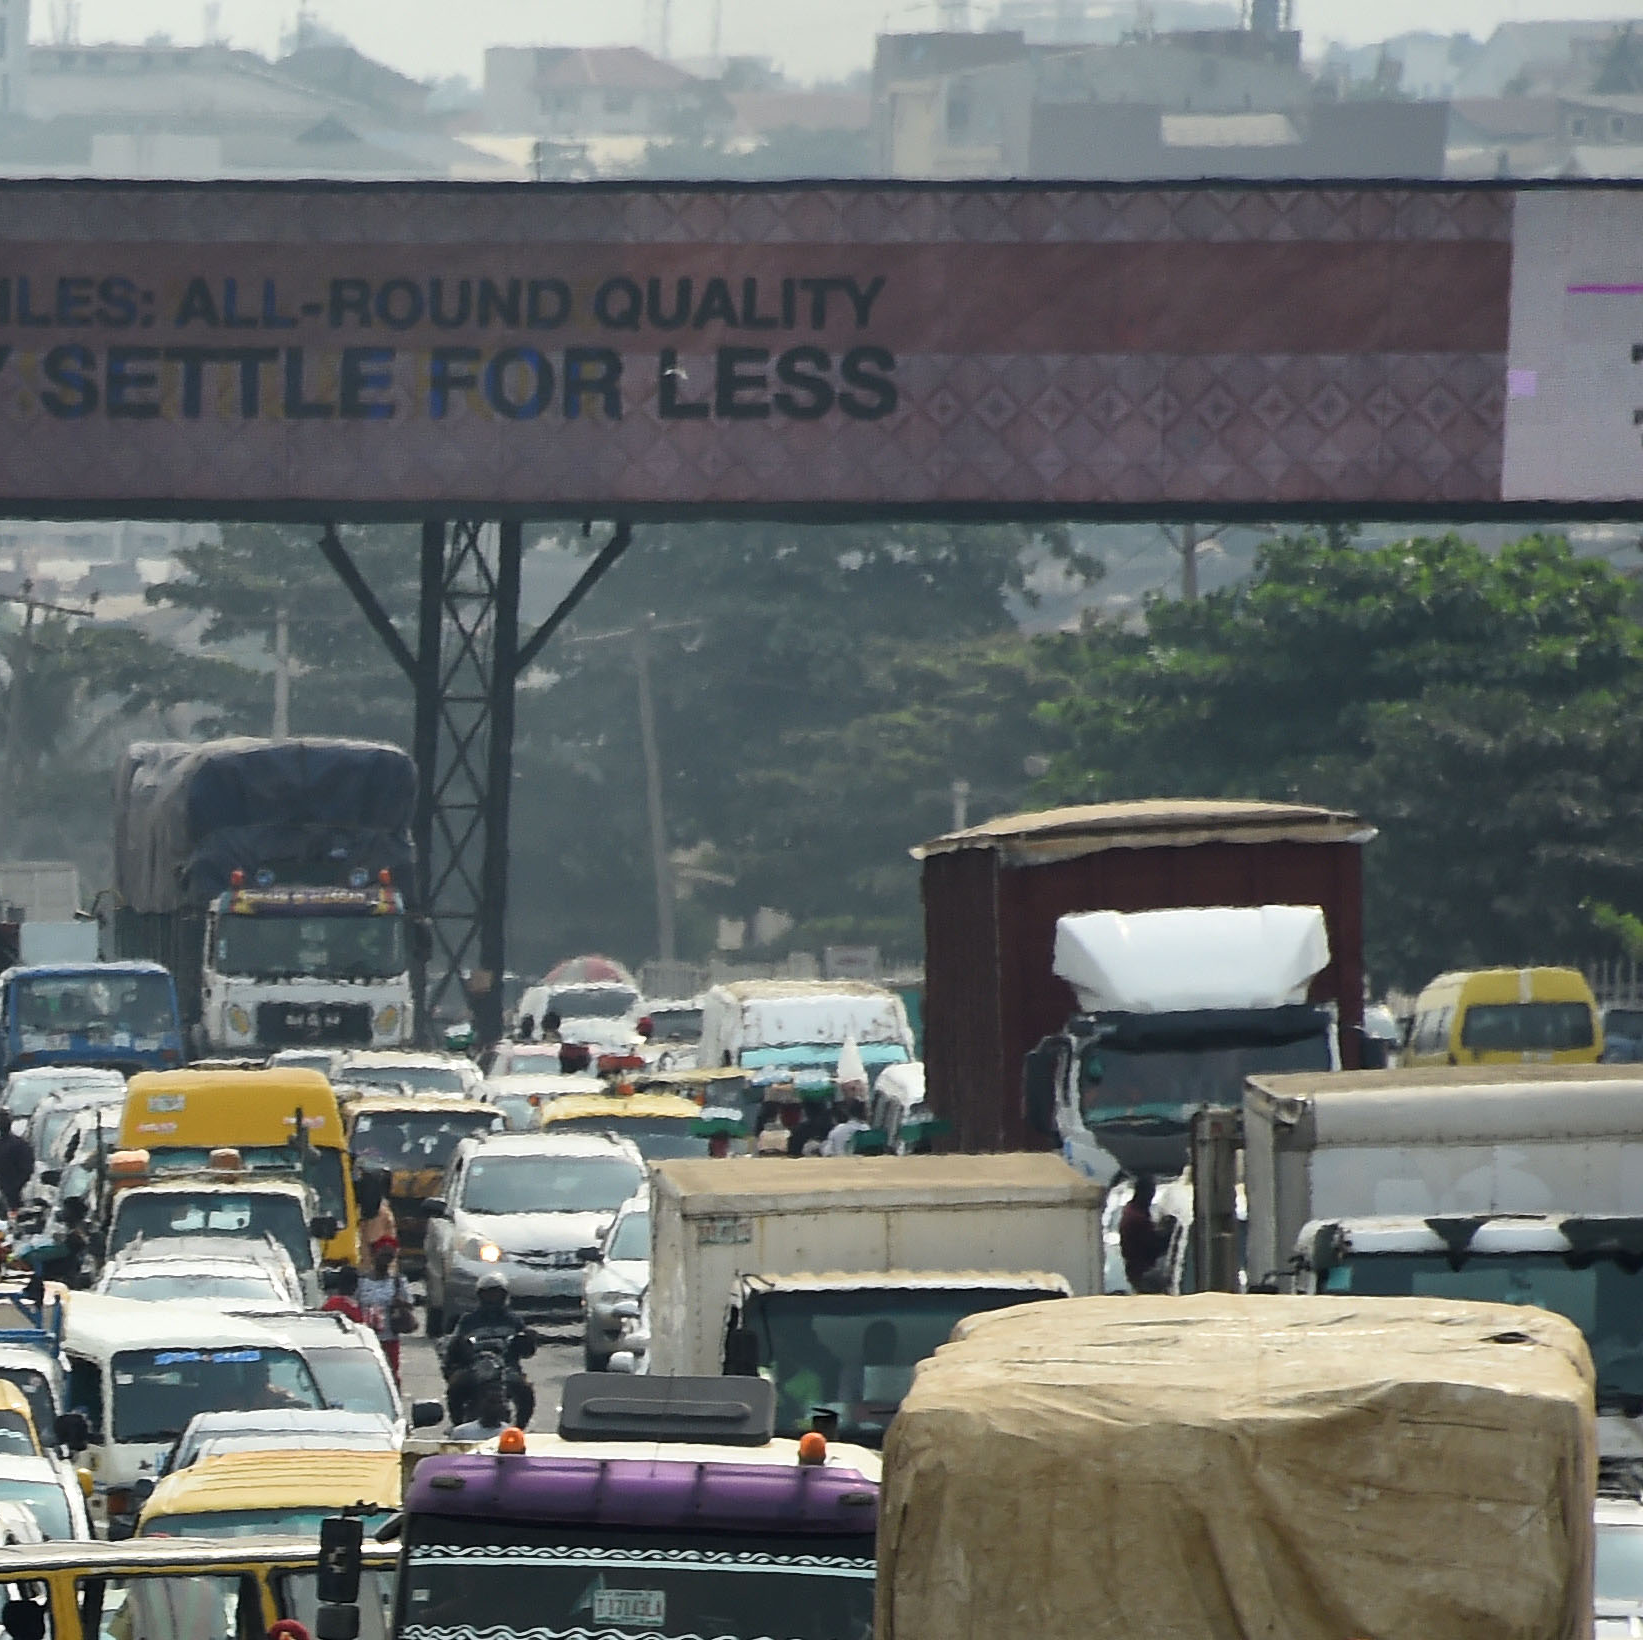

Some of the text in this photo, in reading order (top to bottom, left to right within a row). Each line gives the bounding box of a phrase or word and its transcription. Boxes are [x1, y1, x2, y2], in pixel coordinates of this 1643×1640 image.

[175, 276, 573, 330] ALL-ROUND
[593, 275, 886, 331] QUALITY
[40, 343, 397, 420] SETTLE
[429, 345, 624, 420] FOR
[658, 345, 898, 421] LESS
